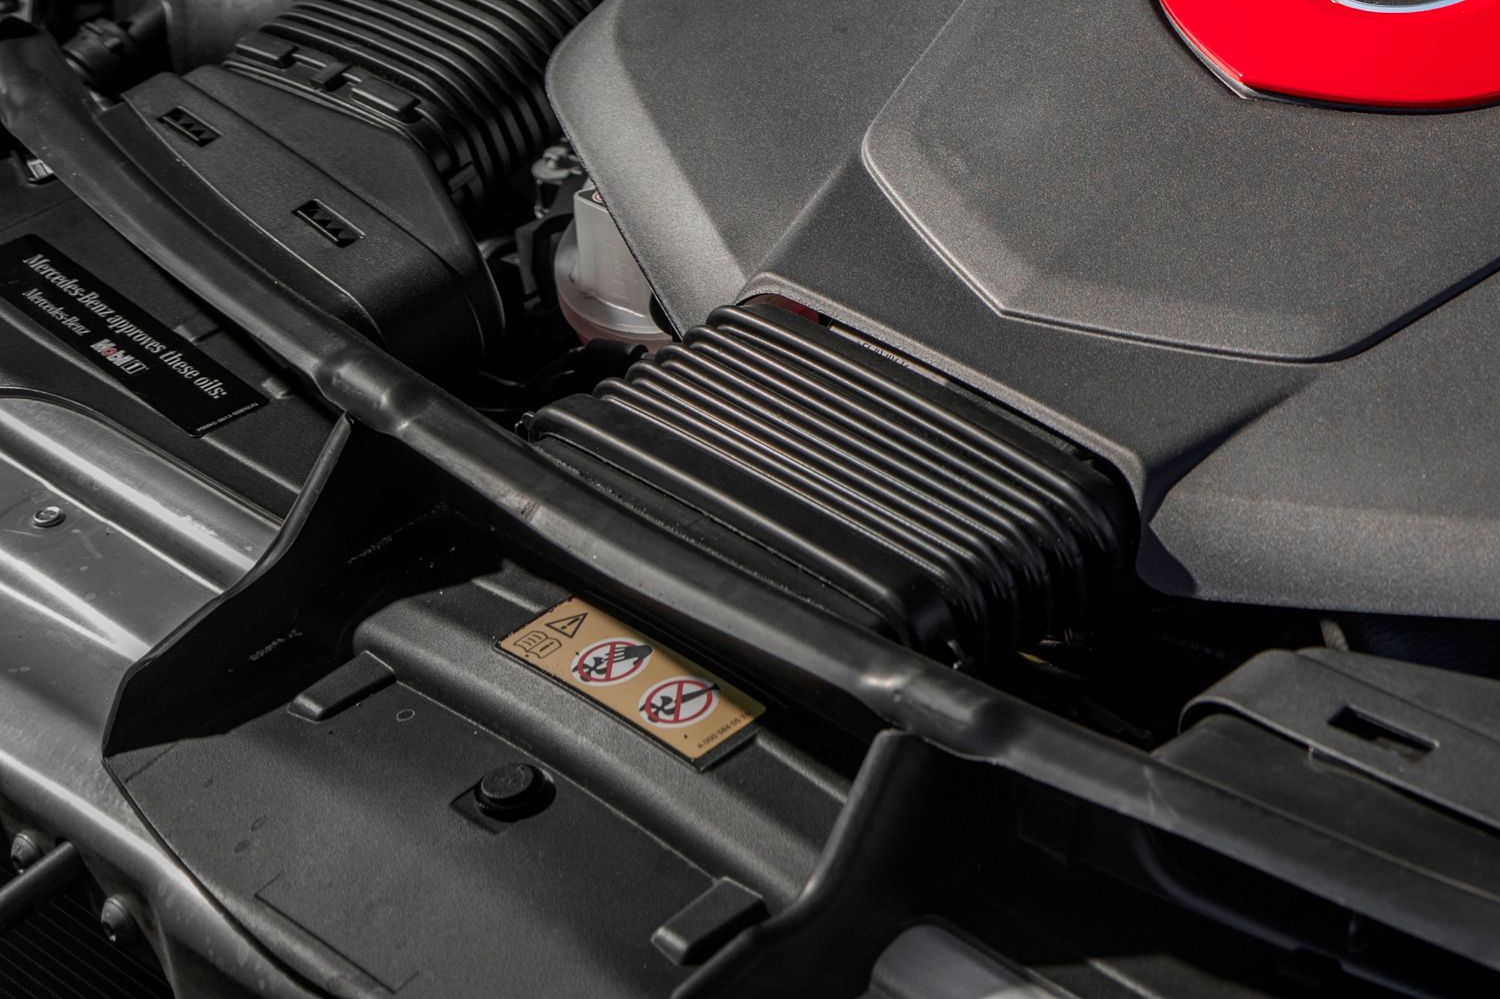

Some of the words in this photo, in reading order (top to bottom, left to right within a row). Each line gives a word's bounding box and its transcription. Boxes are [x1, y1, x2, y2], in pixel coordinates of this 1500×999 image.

[21, 288, 91, 336] Mercedes-Benz
[22, 253, 116, 317] Mercedes-Benz
[106, 315, 167, 353] approves
[159, 350, 200, 379] these
[193, 377, 228, 399] oils:
[89, 339, 134, 366] Mobil
